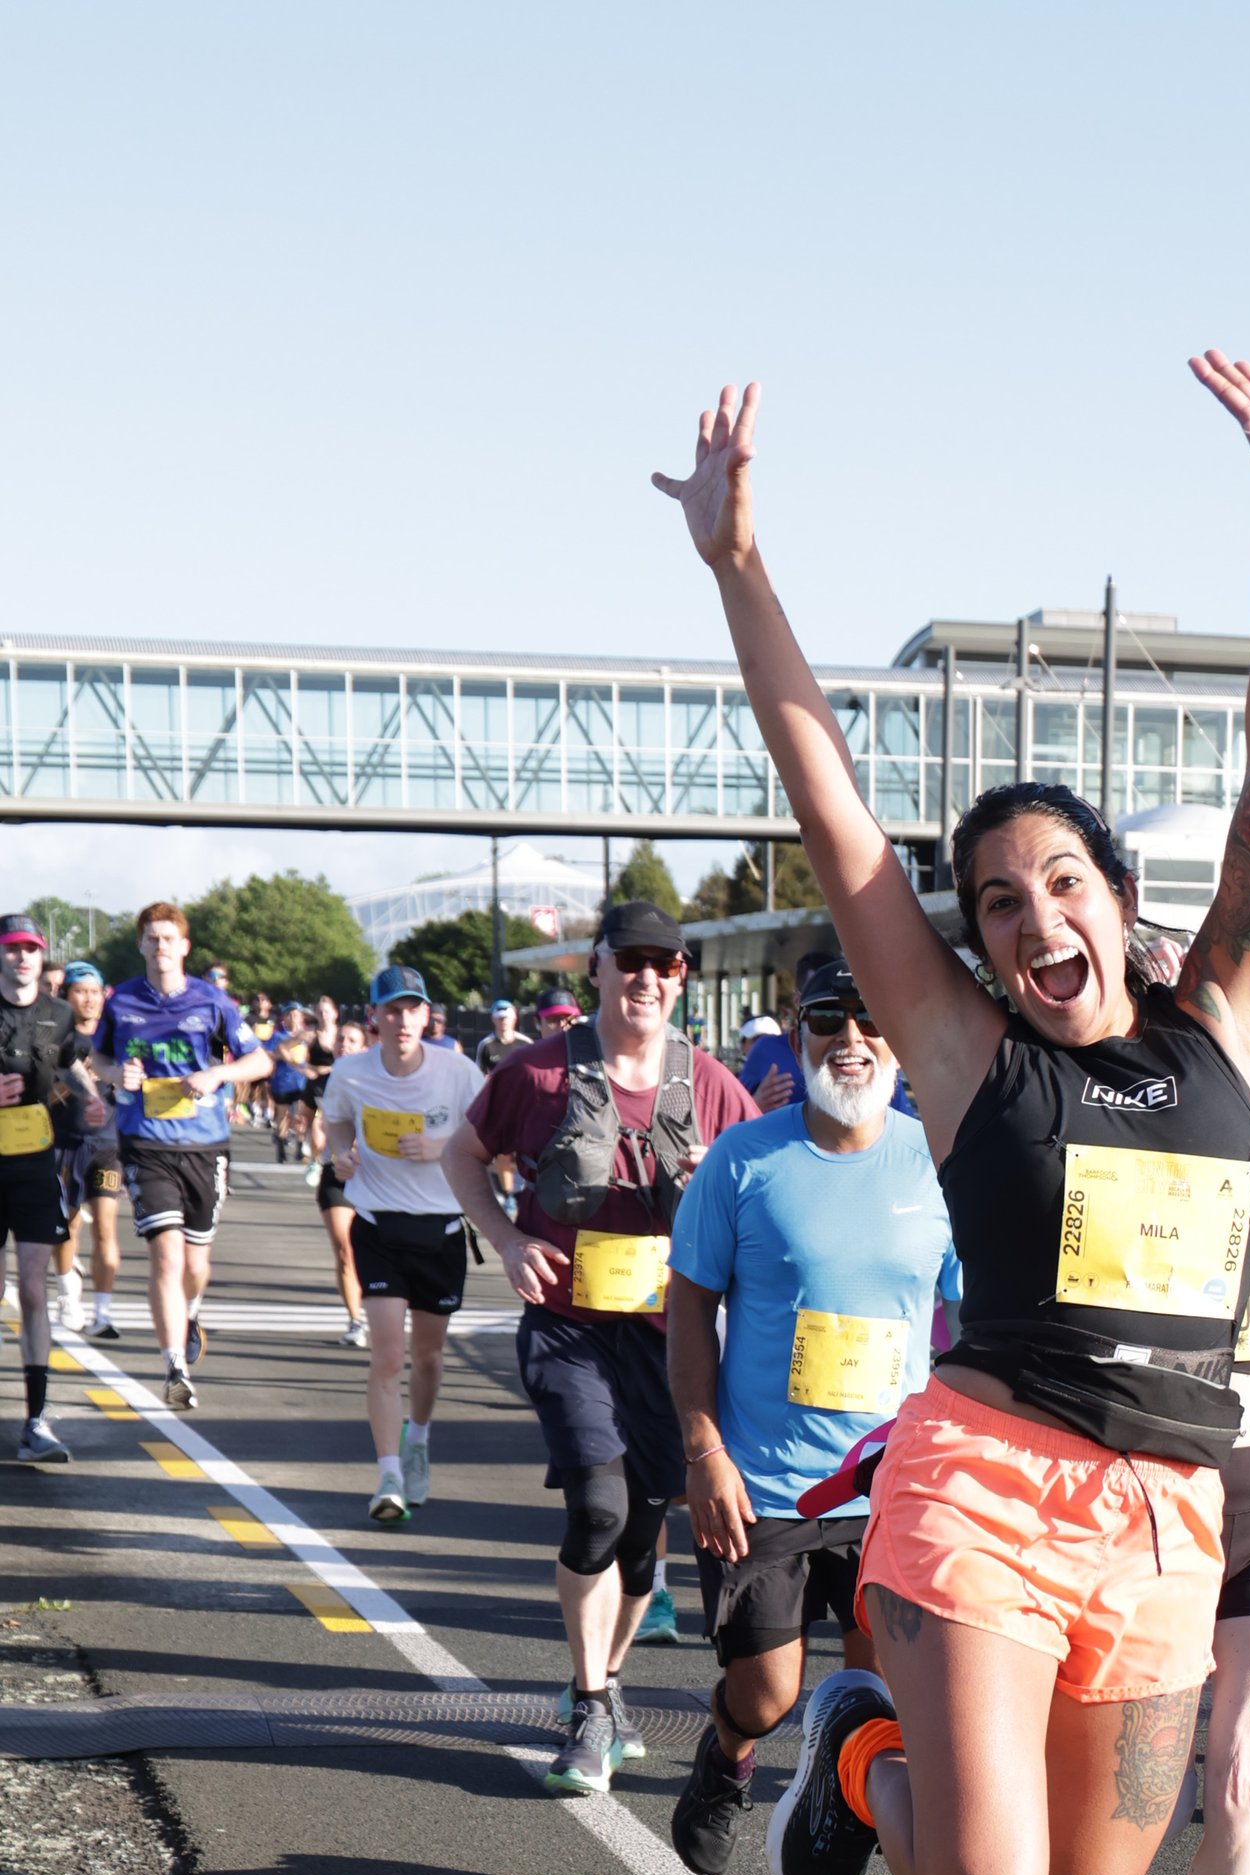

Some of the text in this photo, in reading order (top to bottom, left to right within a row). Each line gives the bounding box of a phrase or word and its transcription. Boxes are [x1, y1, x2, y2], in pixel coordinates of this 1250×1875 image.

[1092, 1082, 1168, 1108] NIKE
[1063, 1190, 1085, 1257] 22826
[1140, 1223, 1179, 1240] MILA
[1224, 1208, 1245, 1272] 22826
[573, 1252, 584, 1284] 23974
[609, 1267, 632, 1277] GREG
[791, 1336, 806, 1376] 23954
[840, 1358, 859, 1368] JAY
